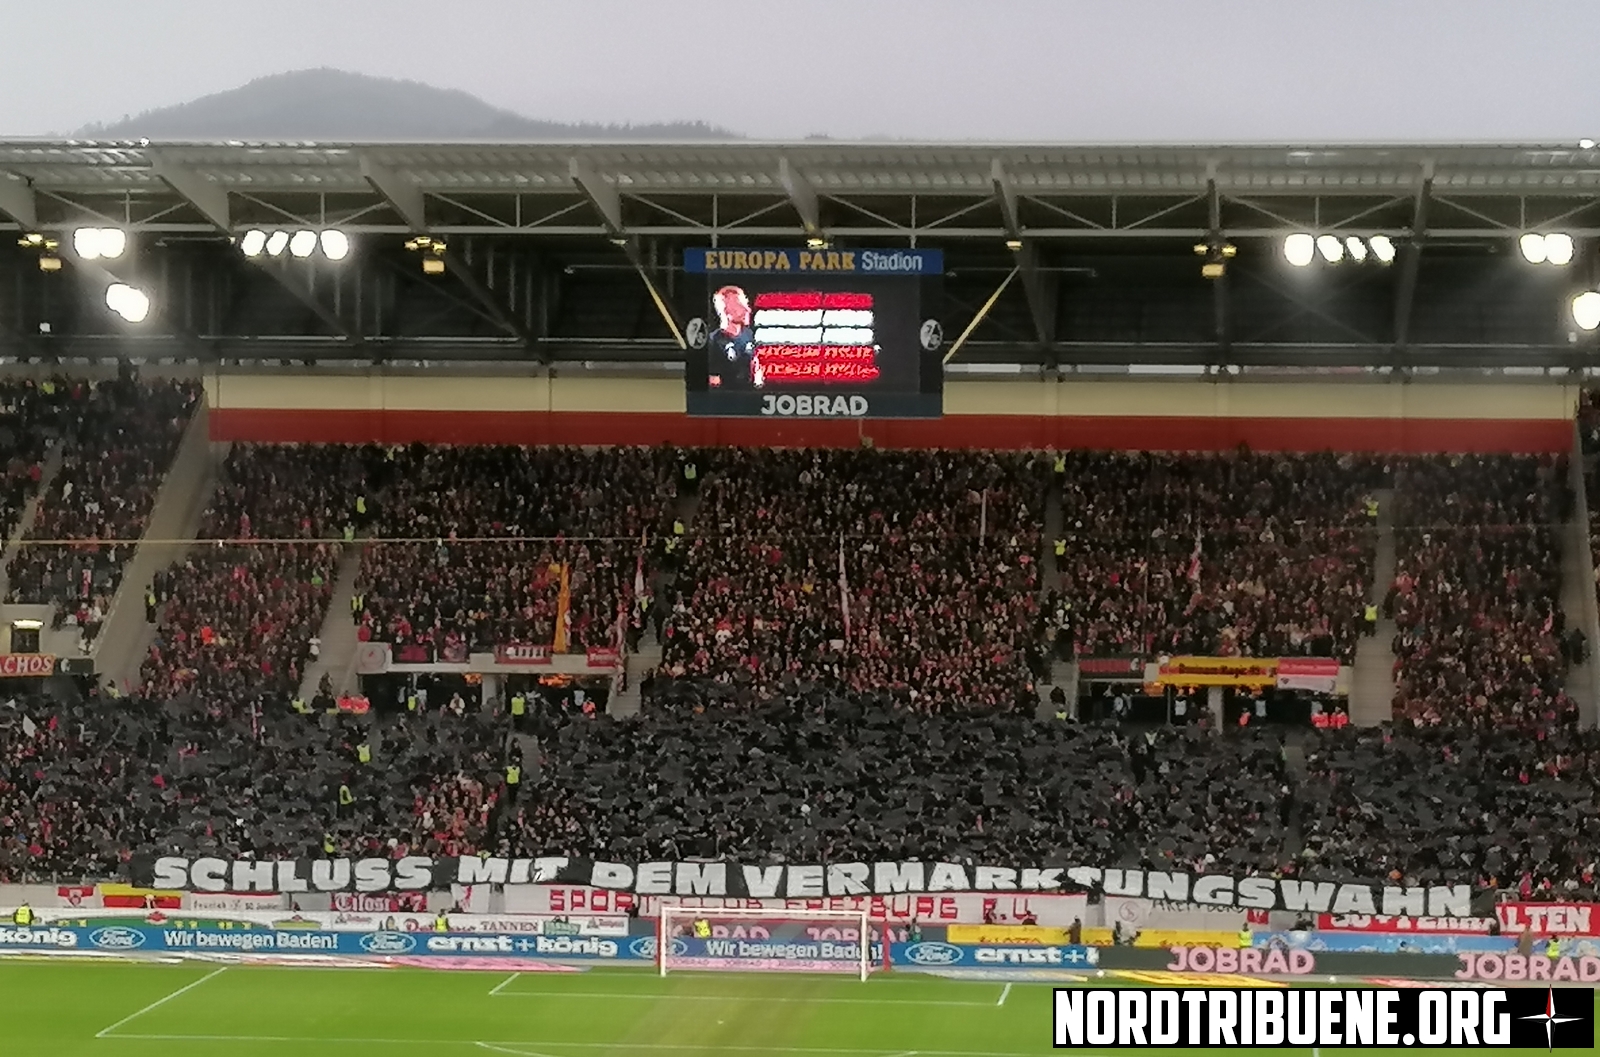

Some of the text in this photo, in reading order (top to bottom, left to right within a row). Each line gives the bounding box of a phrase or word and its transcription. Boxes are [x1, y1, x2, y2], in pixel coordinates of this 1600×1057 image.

[705, 251, 922, 271] EUROPA PARK Stadion
[761, 395, 868, 415] JOBRAD
[0, 656, 53, 674] CHOS
[153, 856, 434, 892] SCHLUSS
[457, 855, 568, 884] MIT
[591, 860, 727, 895] DEM
[742, 860, 1471, 917] VERMARKTUNGSWAHN
[163, 929, 338, 950] Wir bewegen Baden!
[706, 940, 738, 957] Wir
[739, 941, 818, 959] bewegen
[1167, 946, 1316, 976] JOBRAD
[1455, 953, 1600, 982] JOBRAD
